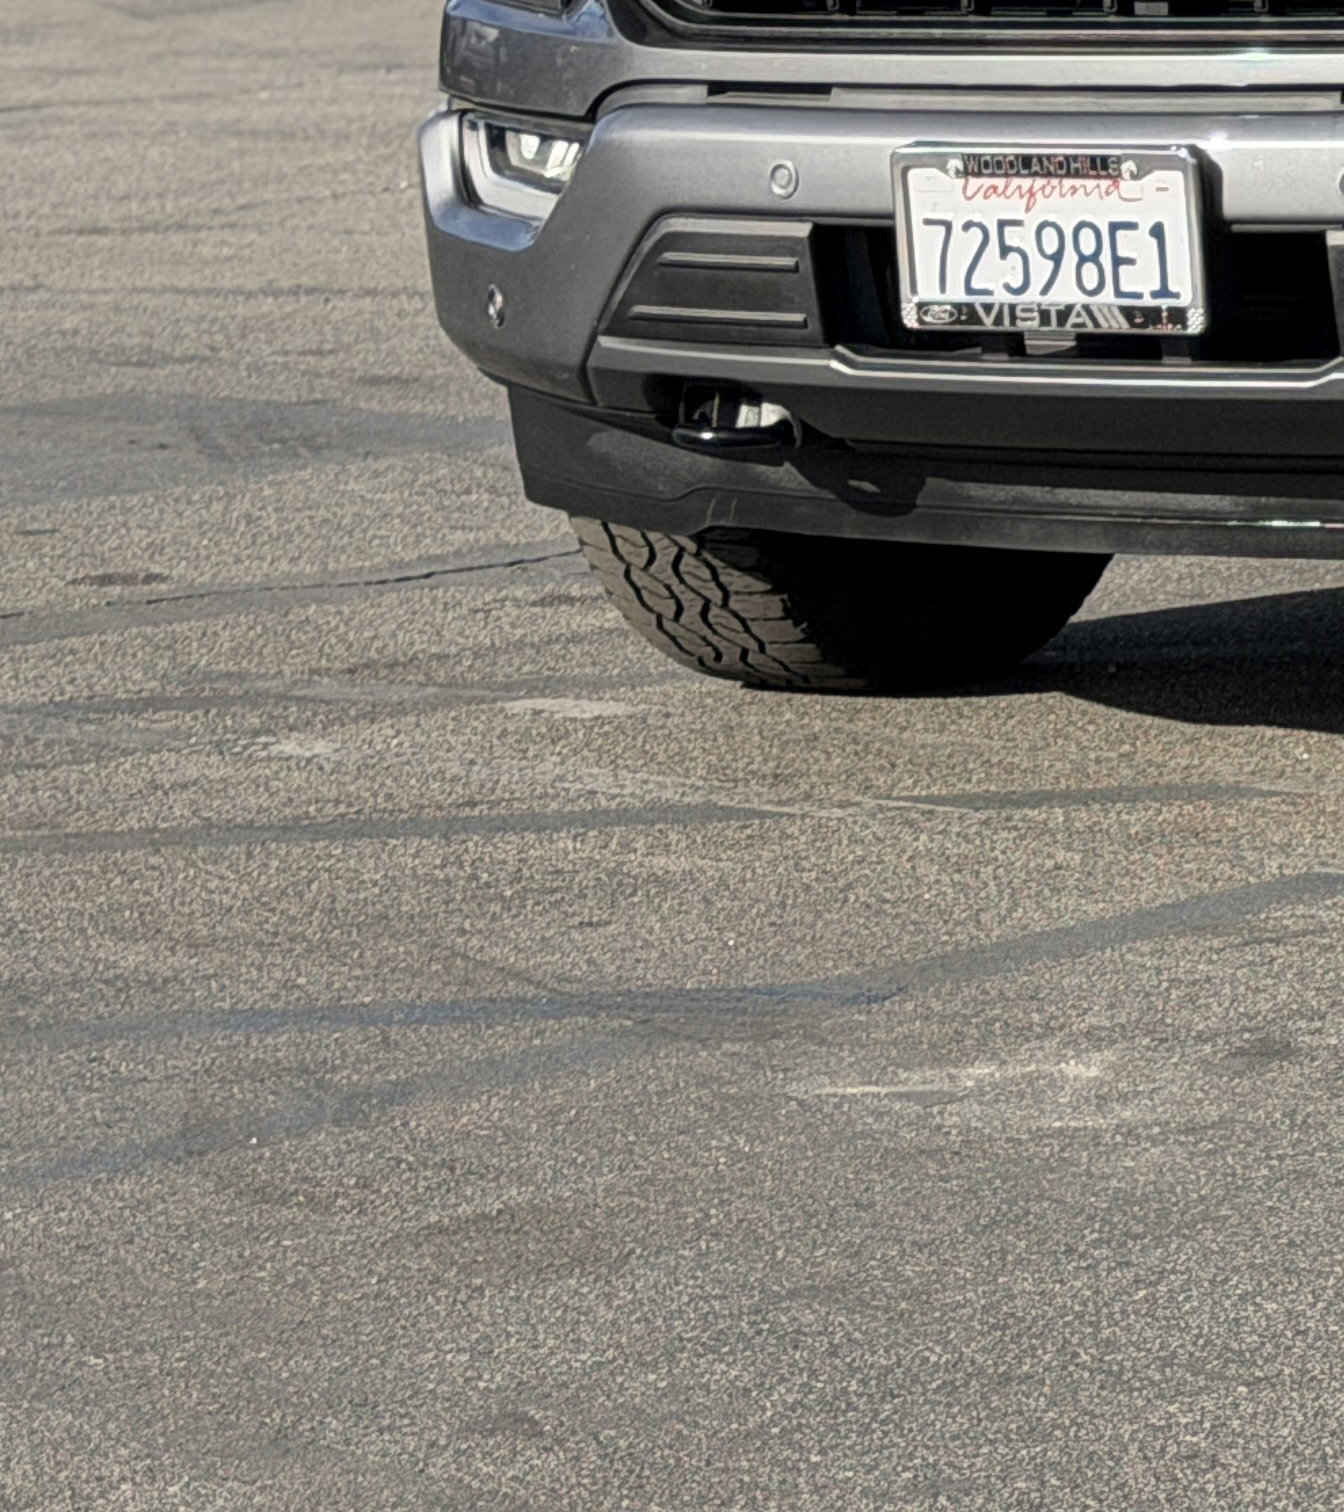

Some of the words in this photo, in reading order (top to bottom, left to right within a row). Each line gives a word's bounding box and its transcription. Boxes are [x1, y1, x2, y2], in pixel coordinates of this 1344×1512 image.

[963, 154, 1068, 177] WOODLAND
[1070, 154, 1121, 176] HILLS
[961, 176, 1144, 214] California
[922, 218, 1182, 301] 72598E1
[973, 301, 1095, 330] VISTA
